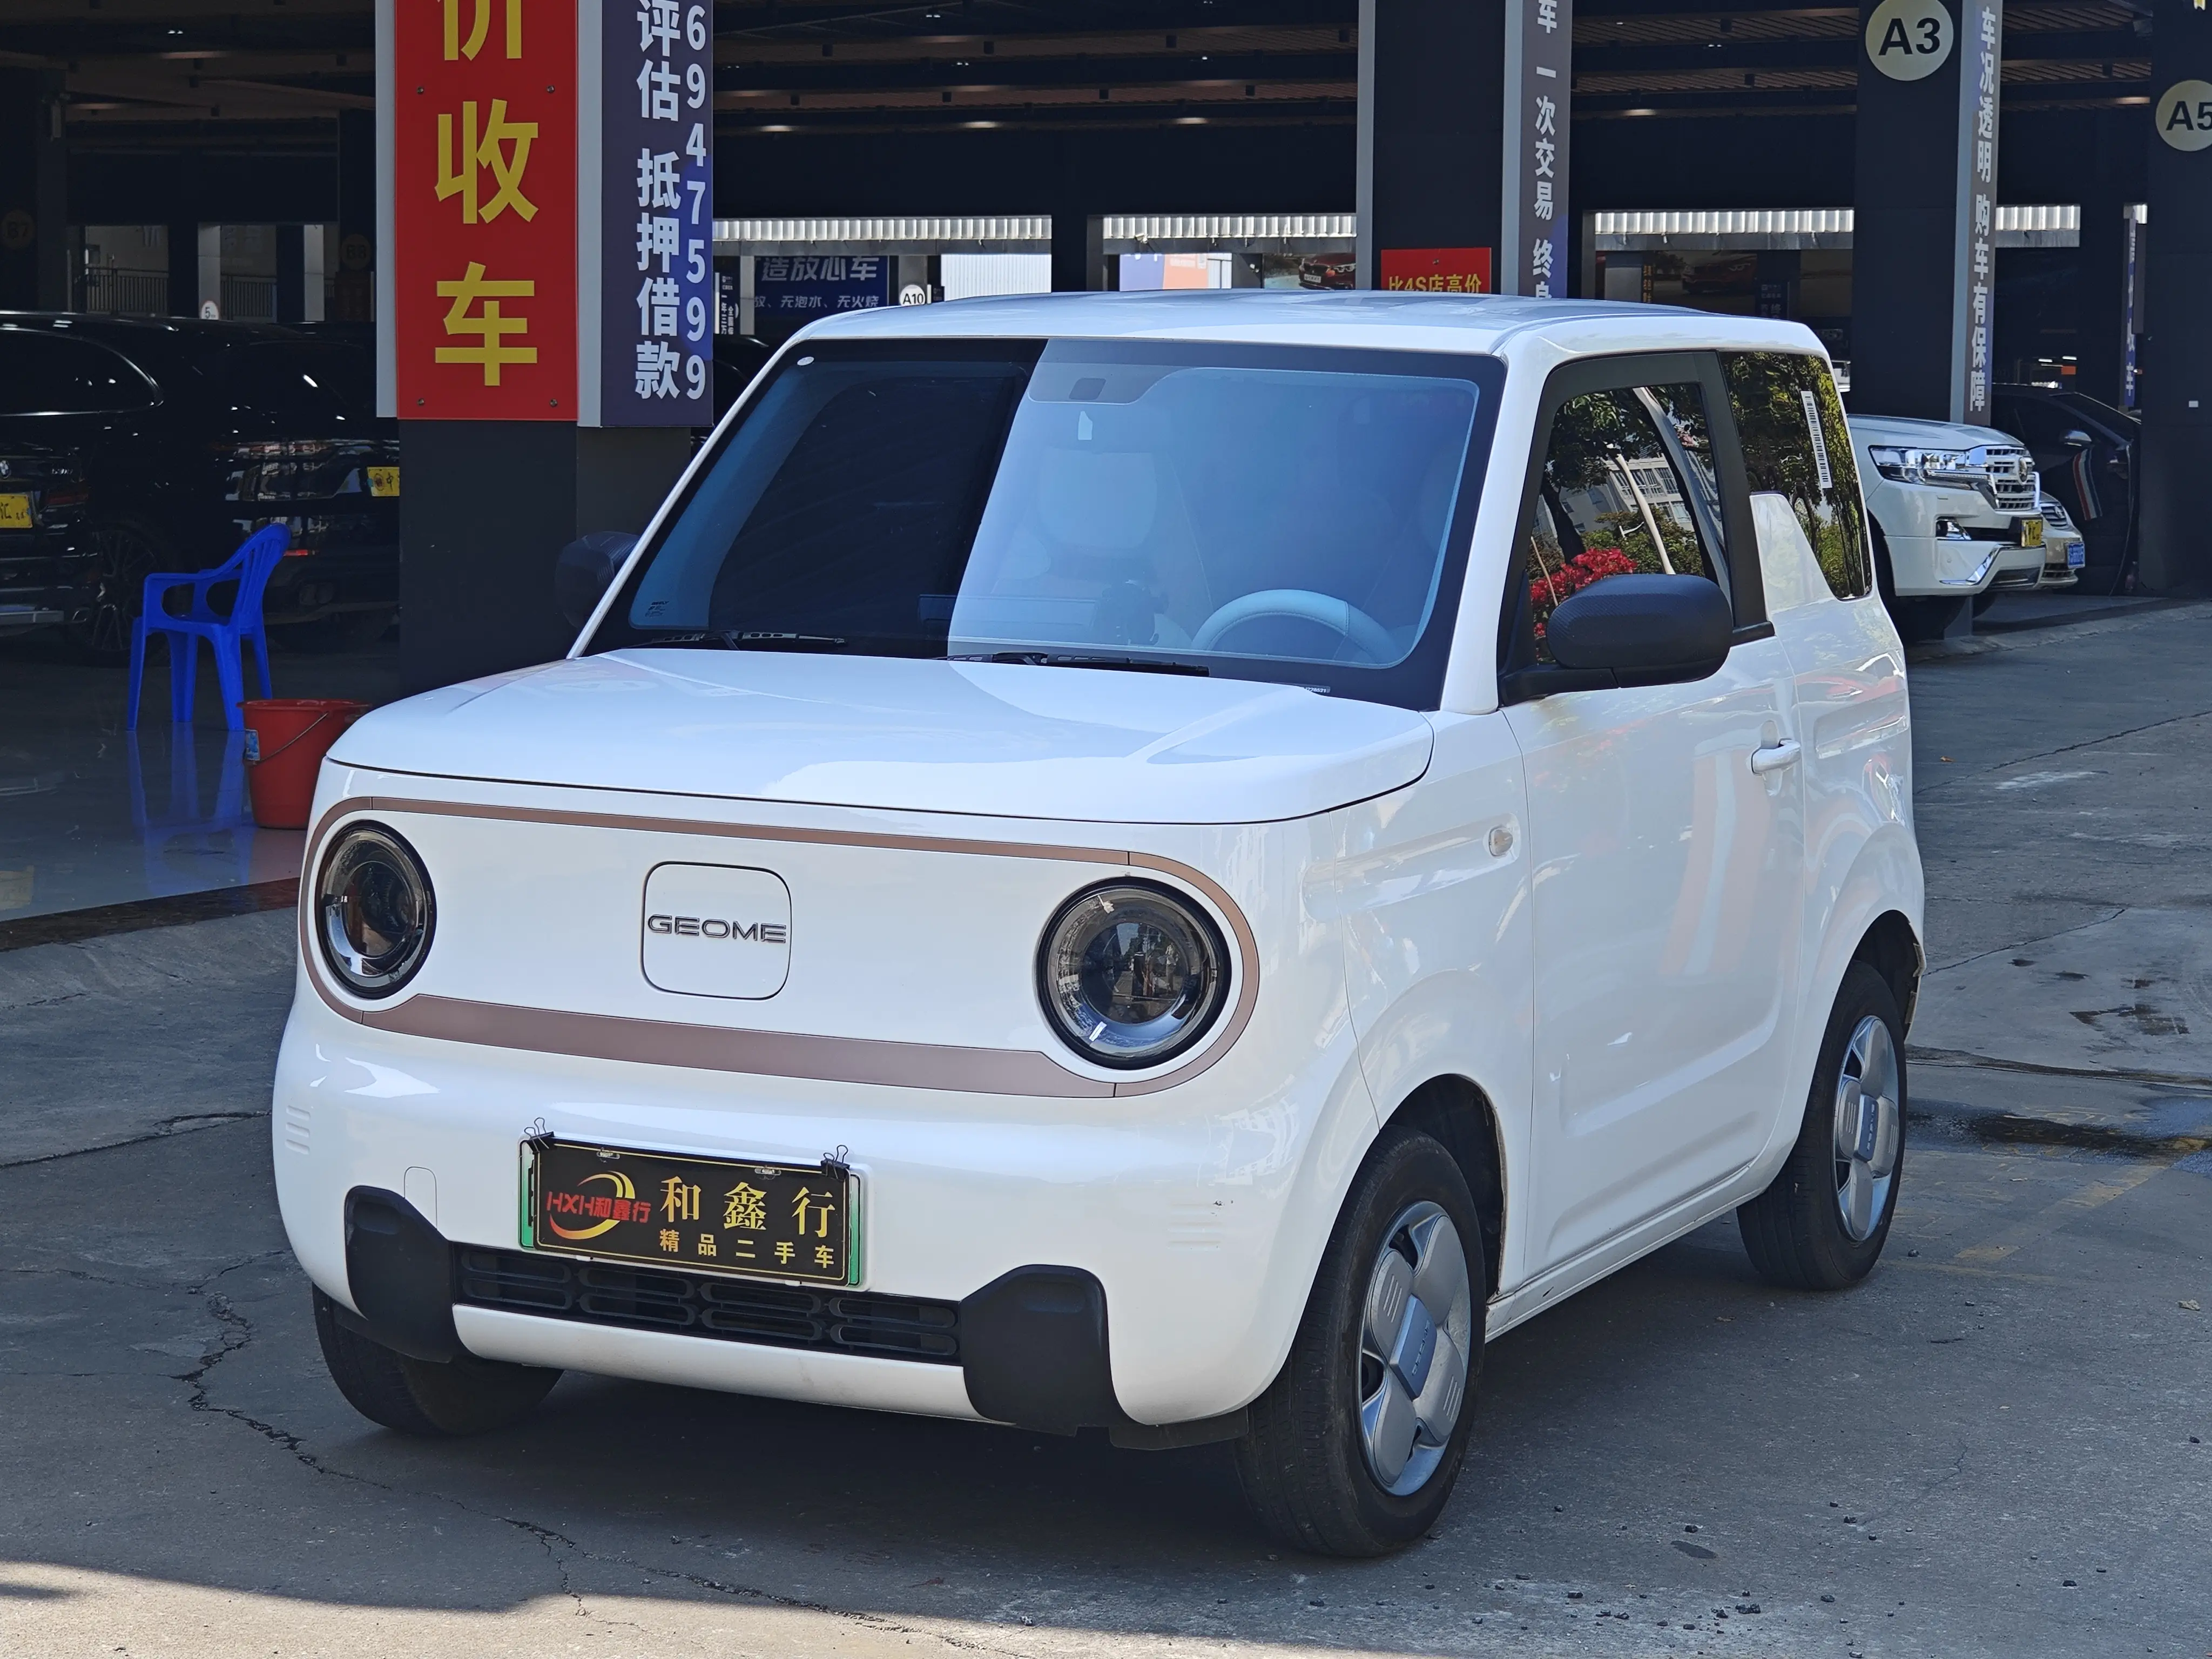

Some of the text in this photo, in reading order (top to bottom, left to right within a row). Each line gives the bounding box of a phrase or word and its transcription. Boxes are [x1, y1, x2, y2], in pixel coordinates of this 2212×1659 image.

[1878, 17, 1941, 55] A3
[2166, 100, 2212, 130] A5
[1534, 66, 1556, 220] 一次交易
[636, 0, 680, 400] 评估 抵押借款
[686, 5, 706, 400] 6947599
[1969, 6, 1996, 412] 车况透明 购车有保障
[754, 257, 880, 281] 造放心车
[902, 293, 923, 304] A10
[648, 914, 787, 943] GEOME
[659, 1176, 835, 1237] 和鑫行
[659, 1229, 834, 1268] 精品二手车
